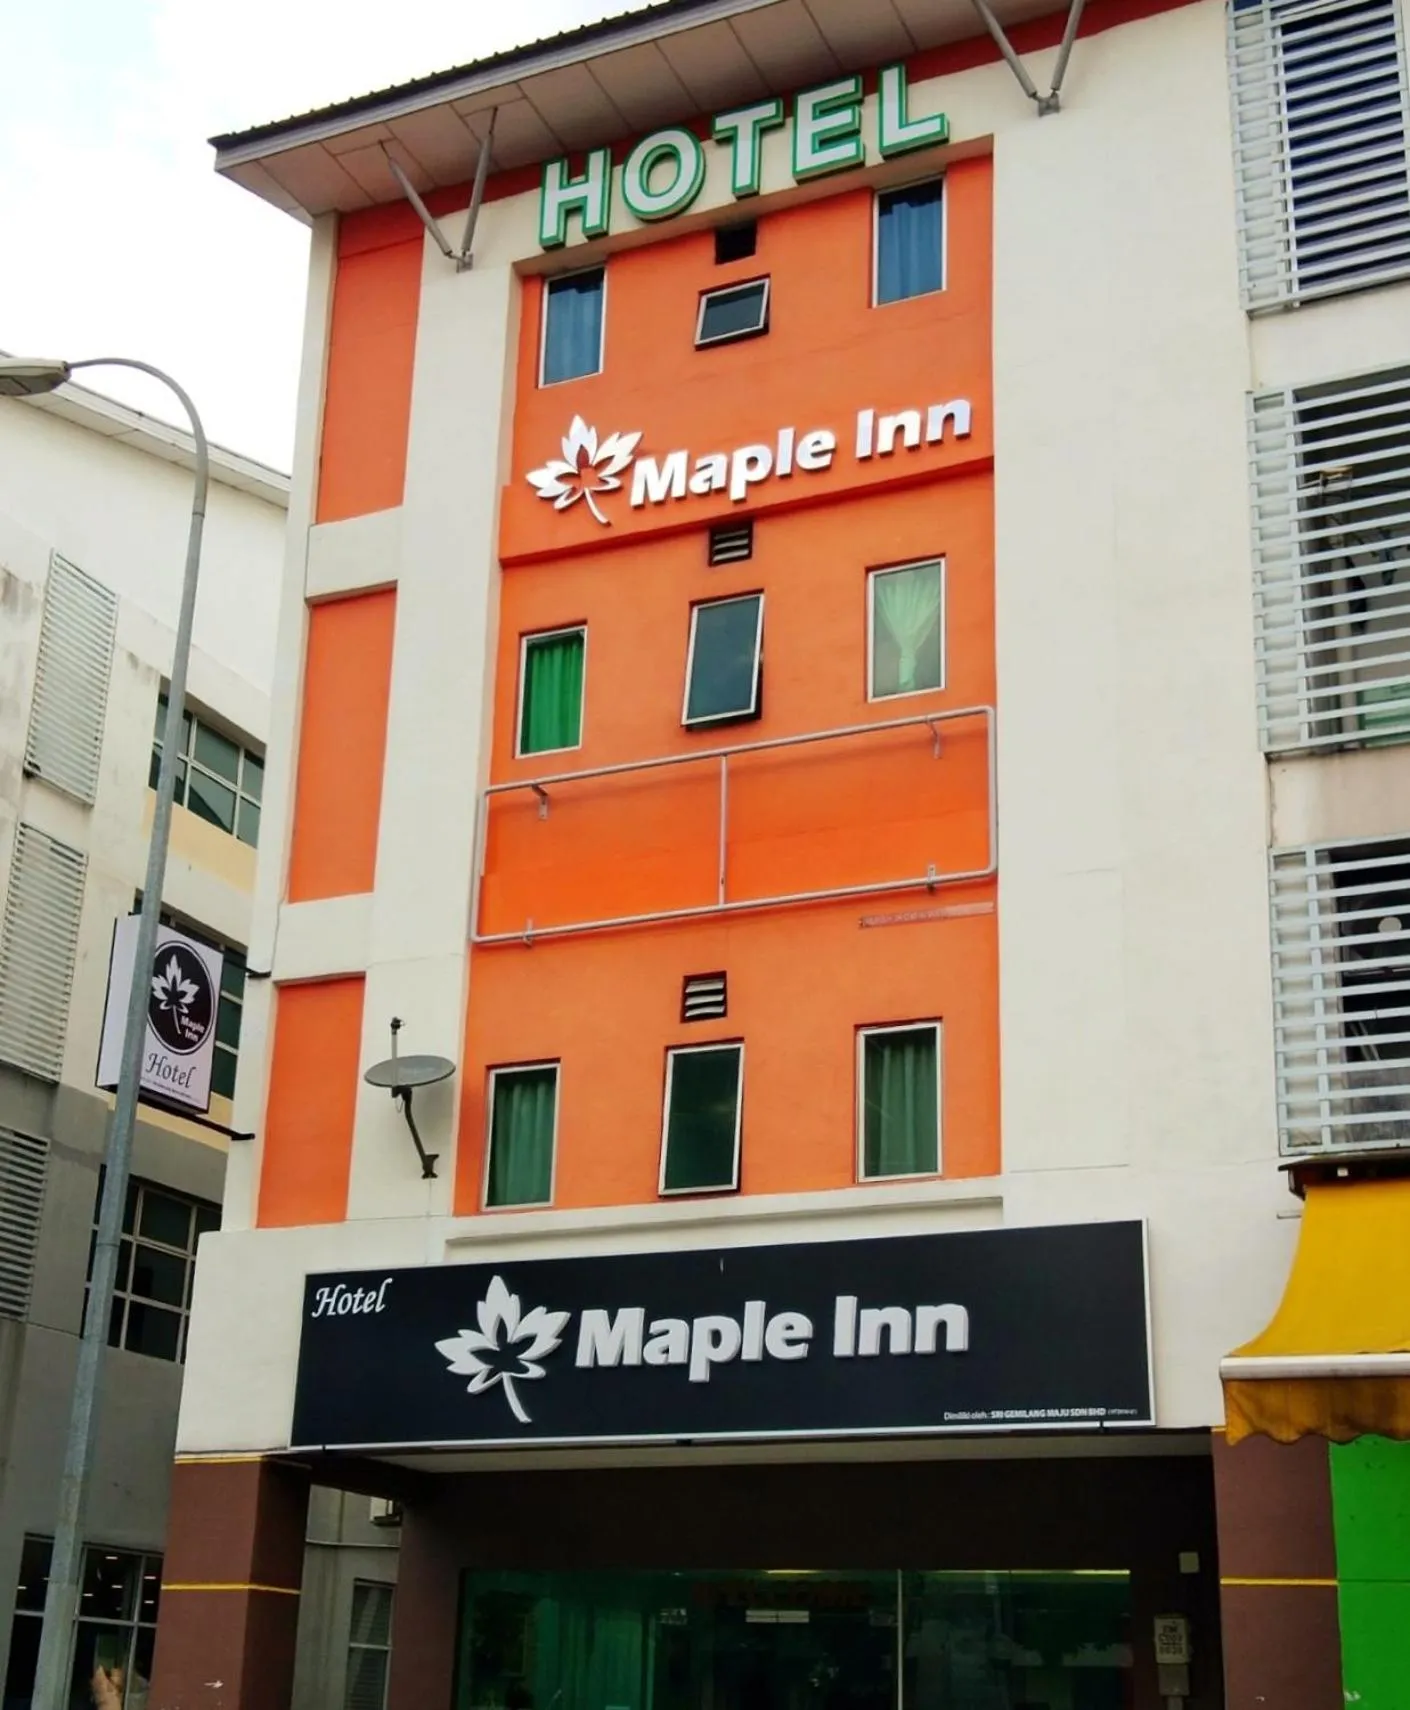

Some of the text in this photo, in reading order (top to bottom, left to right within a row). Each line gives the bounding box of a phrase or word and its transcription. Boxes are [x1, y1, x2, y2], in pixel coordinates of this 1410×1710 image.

[538, 64, 950, 251] HOTEL
[630, 398, 971, 507] Maple Inn
[180, 1014, 206, 1042] Maple Inn
[145, 1052, 197, 1088] Hotel
[312, 1277, 393, 1318] Hotel
[575, 1295, 969, 1382] Maple Inn
